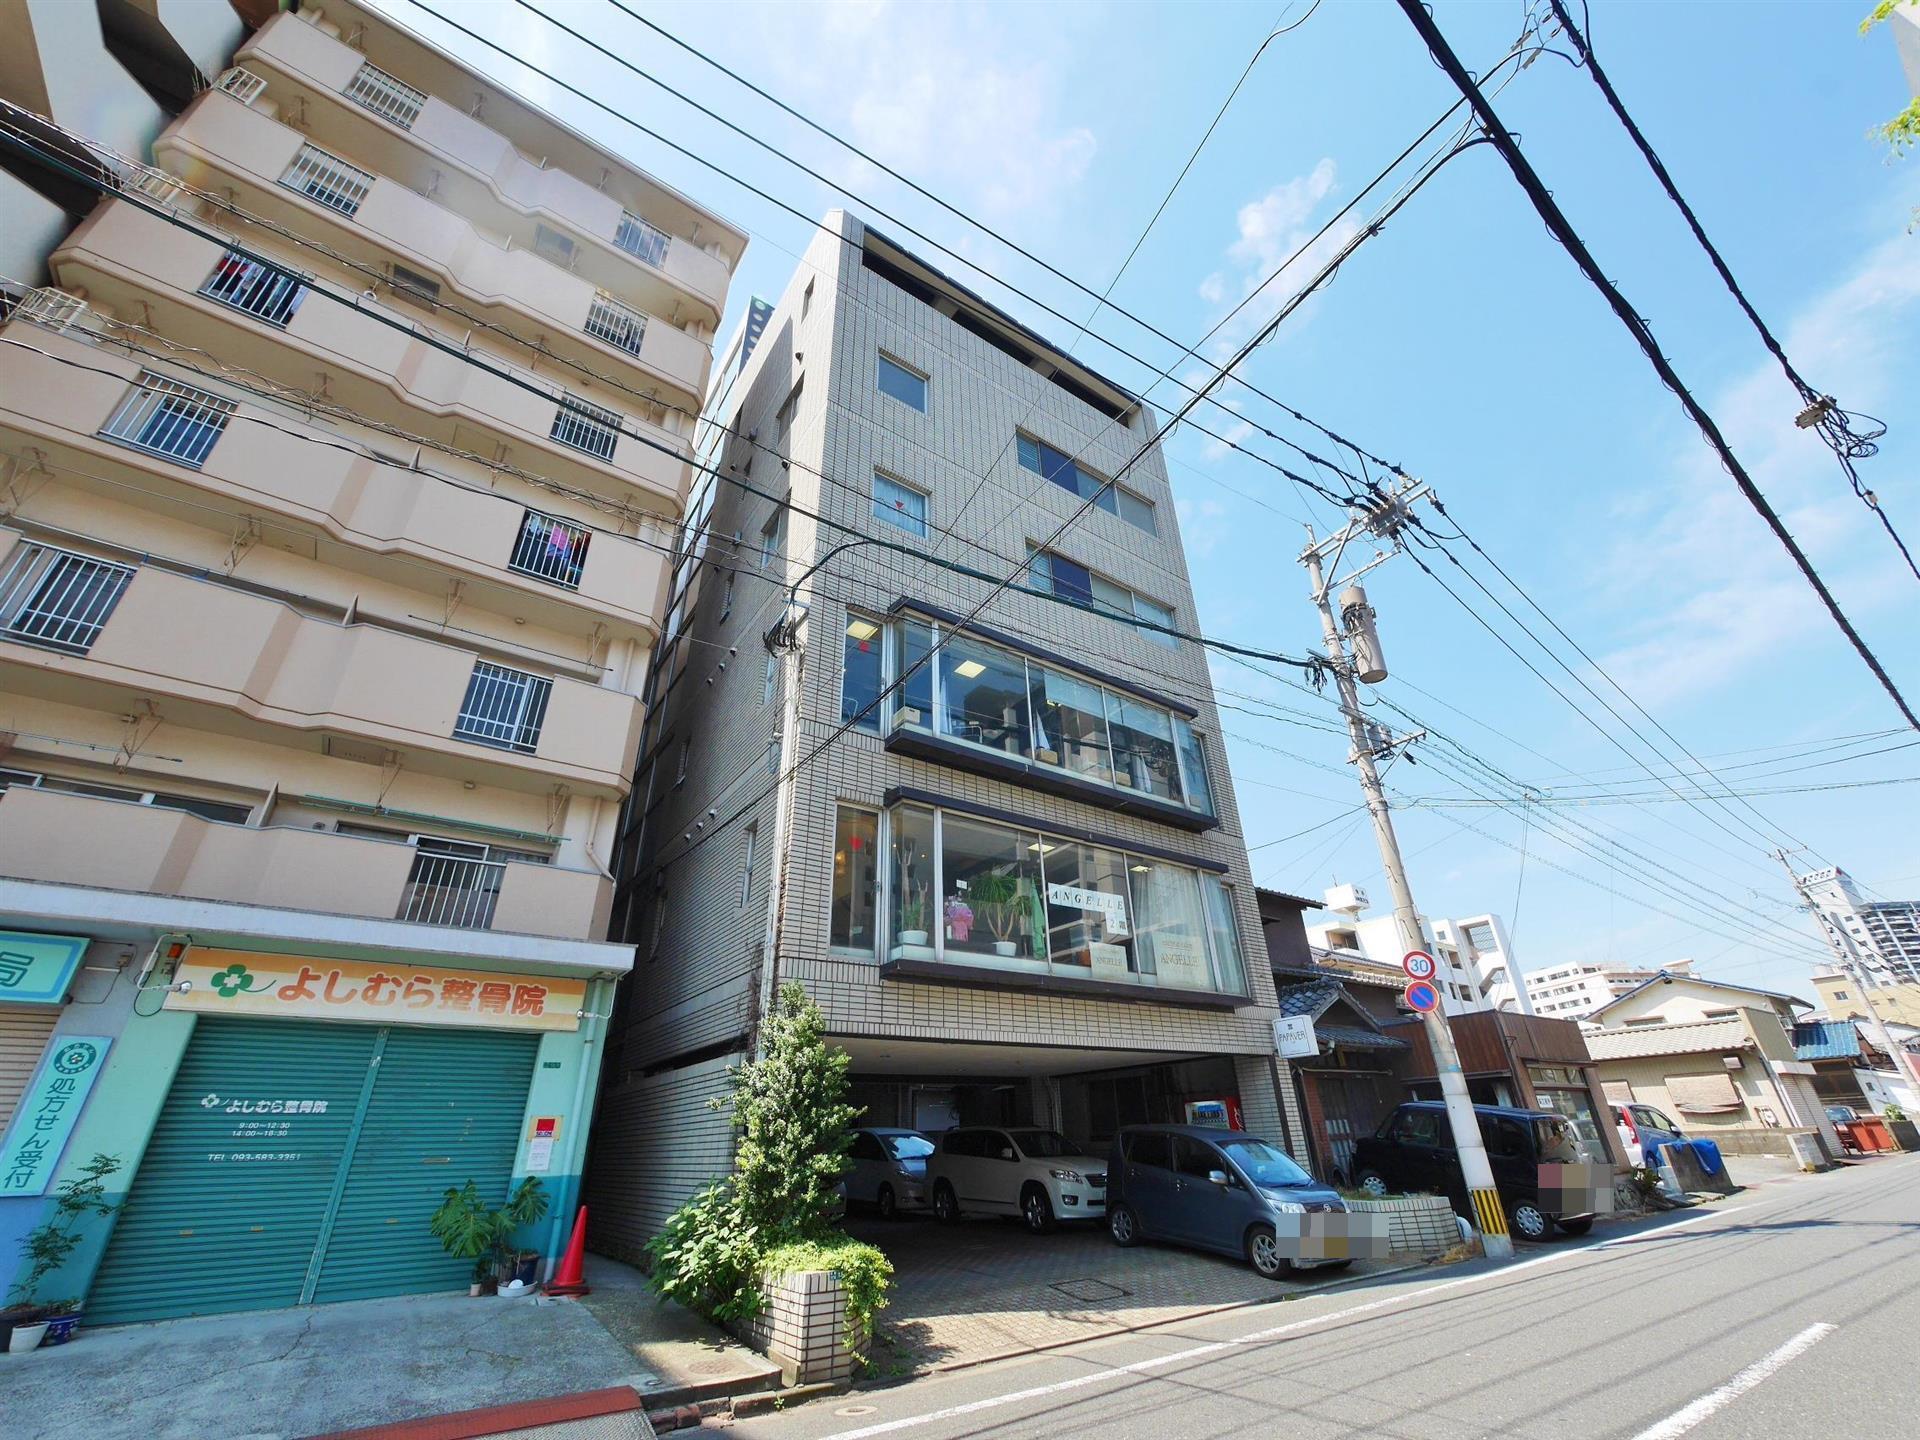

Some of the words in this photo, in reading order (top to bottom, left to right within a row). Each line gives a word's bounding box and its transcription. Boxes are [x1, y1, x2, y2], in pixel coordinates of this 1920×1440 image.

[1052, 890, 1124, 911] ANGELLE
[1410, 958, 1428, 973] 30
[277, 966, 547, 1017] よしむら整骨院
[1278, 1030, 1306, 1042] PAPAVER
[226, 1100, 328, 1113] よしむら整骨院
[4, 1078, 76, 1189] 処方せん受付
